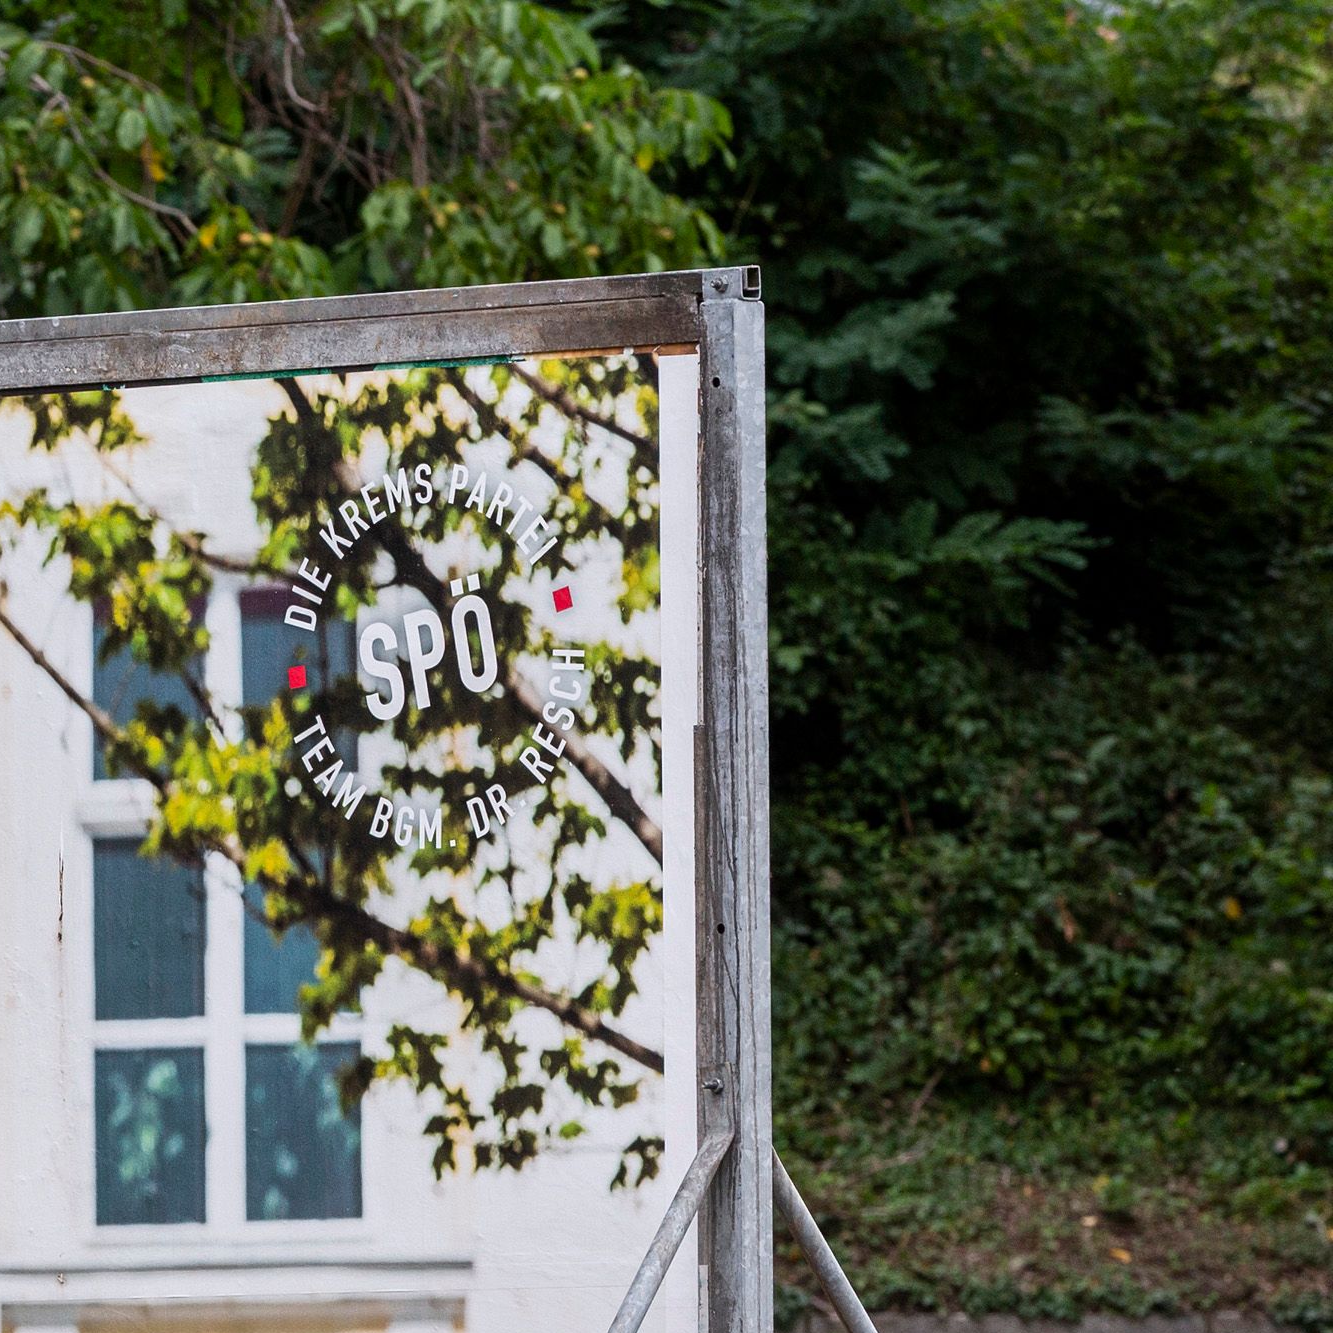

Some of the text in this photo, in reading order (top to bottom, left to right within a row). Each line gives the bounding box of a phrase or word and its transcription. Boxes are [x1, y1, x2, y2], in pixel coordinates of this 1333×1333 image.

[284, 463, 558, 632] DIE KREMS PARTEI
[359, 573, 498, 721] SPÖ
[293, 648, 585, 849] TEAM BGM. DR. RESCH
